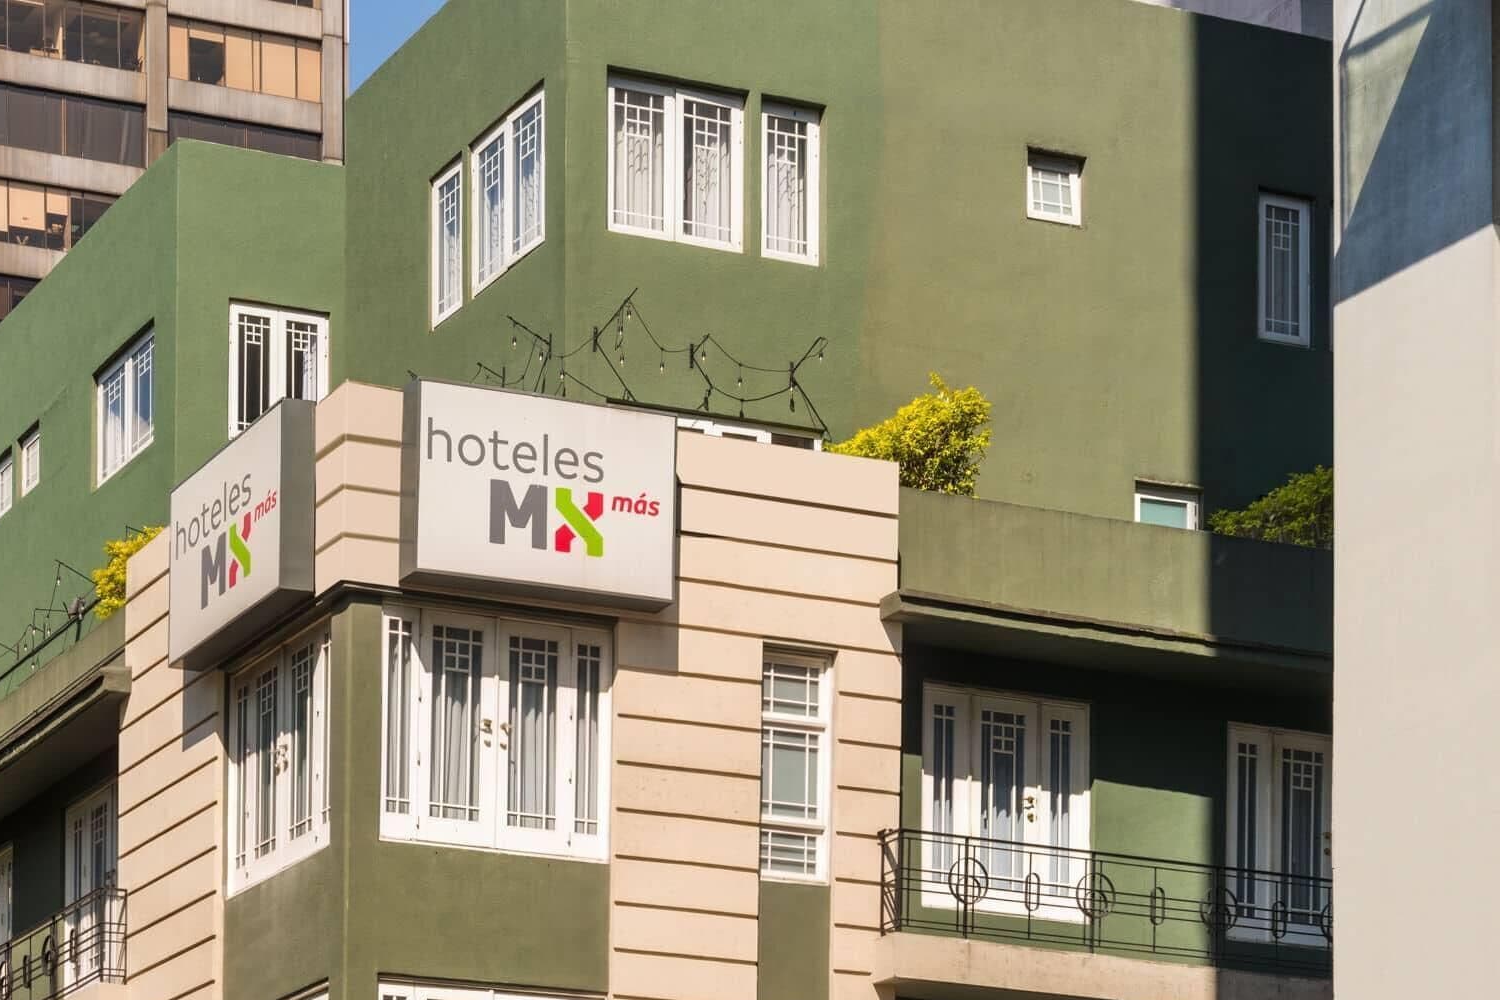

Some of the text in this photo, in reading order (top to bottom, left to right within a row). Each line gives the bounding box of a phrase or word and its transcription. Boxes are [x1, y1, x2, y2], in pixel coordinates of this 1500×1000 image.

[427, 416, 604, 484] hoteles
[175, 473, 251, 561] hoteles
[200, 489, 277, 611] MX más
[488, 478, 661, 558] MX más
